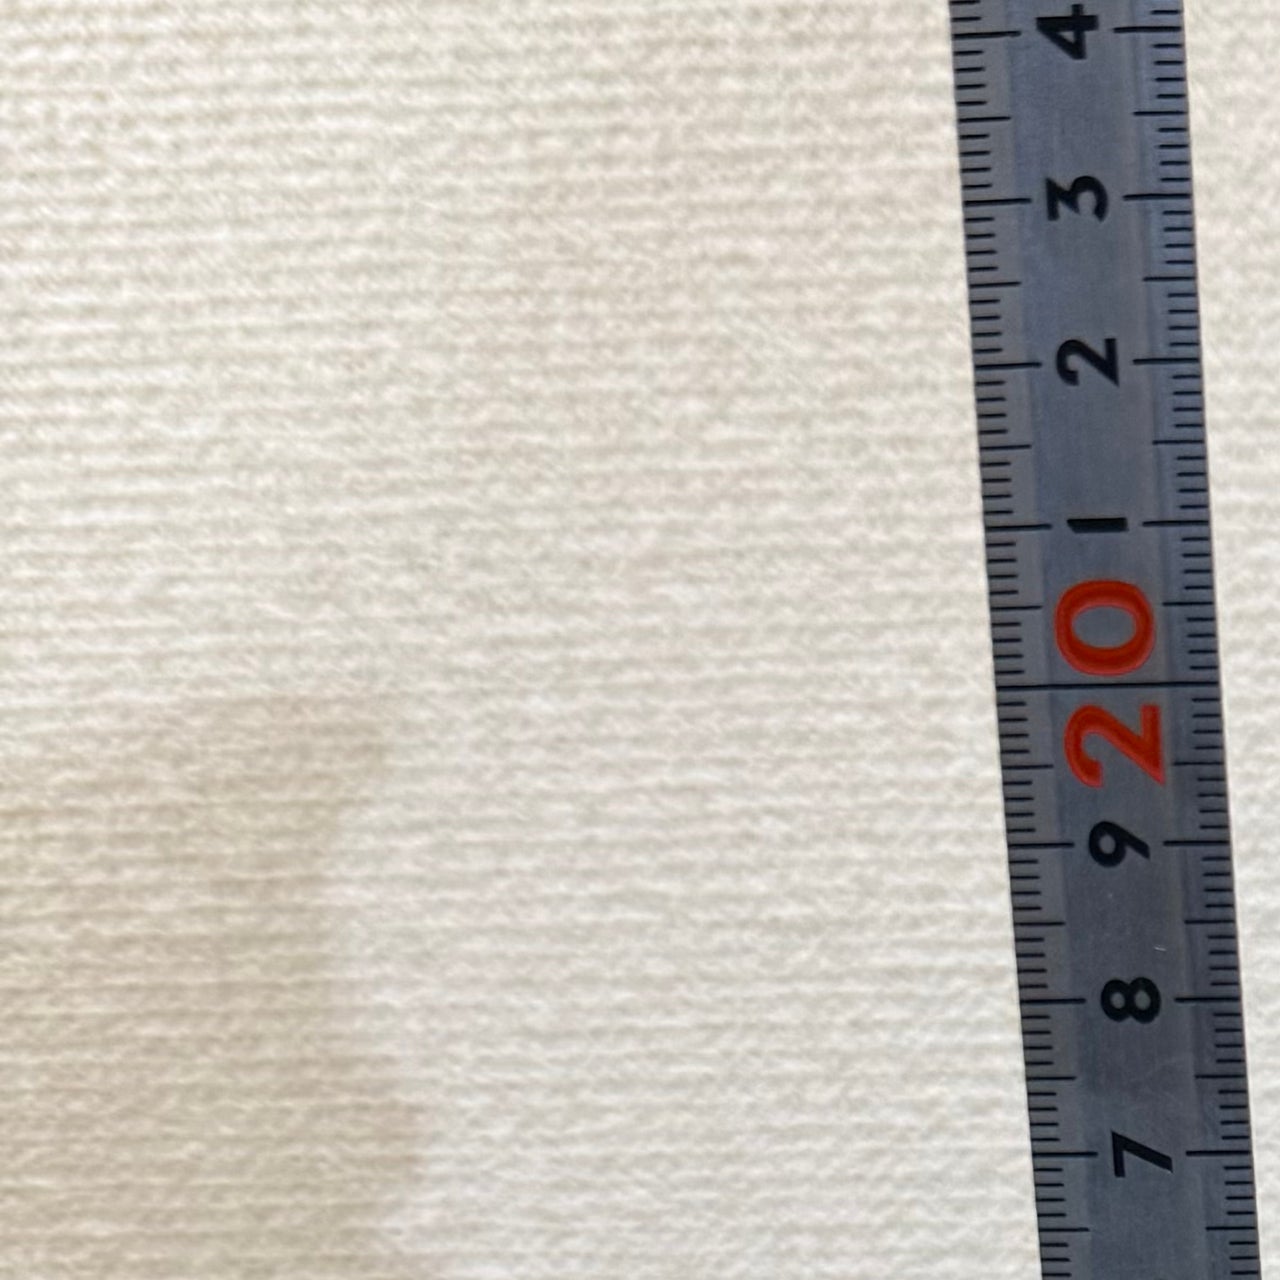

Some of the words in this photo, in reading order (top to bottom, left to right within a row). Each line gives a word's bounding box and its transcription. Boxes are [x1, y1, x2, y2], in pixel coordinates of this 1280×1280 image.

[1036, 4, 1098, 59] 4
[1046, 176, 1107, 220] 3
[1056, 338, 1118, 385] 2
[1067, 518, 1127, 533] 1
[1055, 580, 1163, 786] 20
[1088, 821, 1149, 867] 9
[1100, 977, 1161, 1023] 8
[1112, 1131, 1172, 1177] 7
